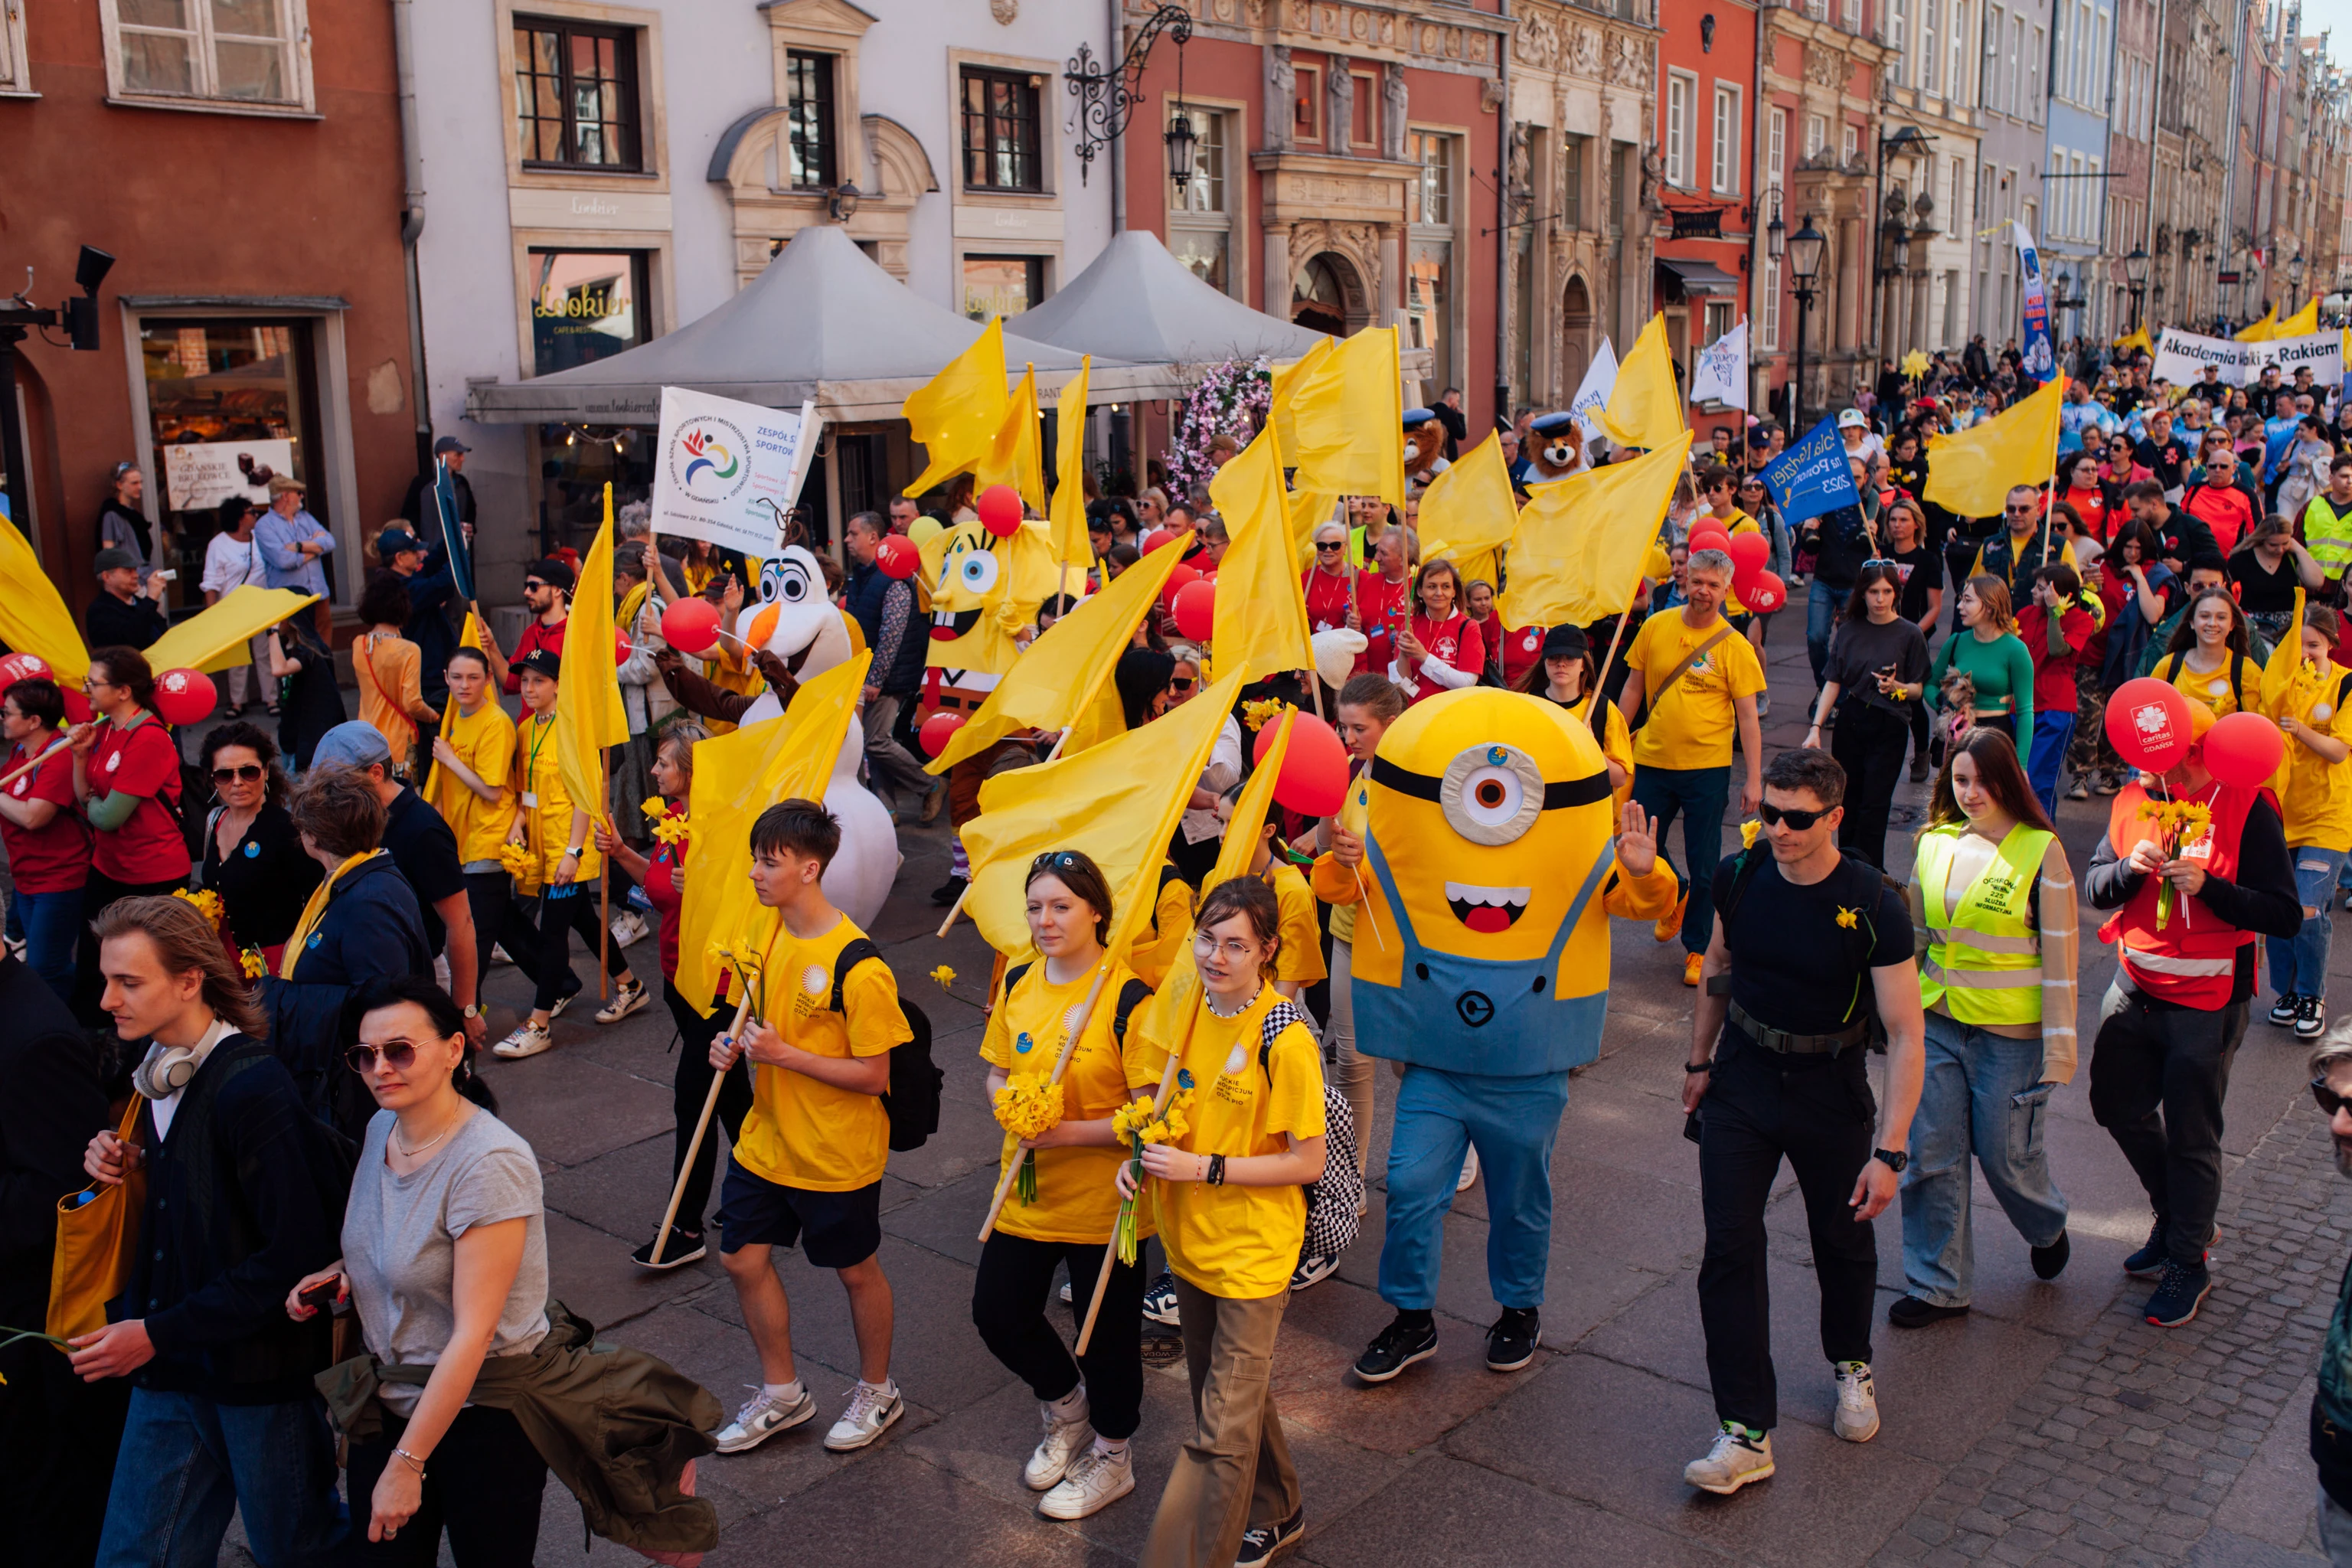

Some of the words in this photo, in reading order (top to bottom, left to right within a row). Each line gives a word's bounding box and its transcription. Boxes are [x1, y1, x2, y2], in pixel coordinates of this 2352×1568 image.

[570, 196, 619, 215] Lookier
[534, 283, 632, 318] Lookier
[965, 286, 1029, 313] Lookier
[2163, 338, 2236, 365] Akademia
[2264, 354, 2274, 364] z
[2279, 342, 2338, 362] Rakiem
[717, 417, 750, 454] MISTRZOSTWA
[757, 426, 788, 442] ZESPÓŁ
[730, 456, 752, 497] SPORTOWEGO
[2142, 732, 2171, 743] caritas
[2144, 740, 2174, 753] GDAŃSK
[1983, 878, 2017, 891] OCHRONA
[547, 884, 579, 900] NIKE
[1975, 902, 2011, 915] INFORMACYJNA
[797, 998, 827, 1011] HOSPICJUM
[798, 992, 815, 1004] PUCKIE
[794, 1008, 807, 1017] OJCA
[1219, 1075, 1239, 1086] PUCKIE
[1217, 1081, 1253, 1096] HOSPICJUM
[1217, 1092, 1230, 1102] OJCA
